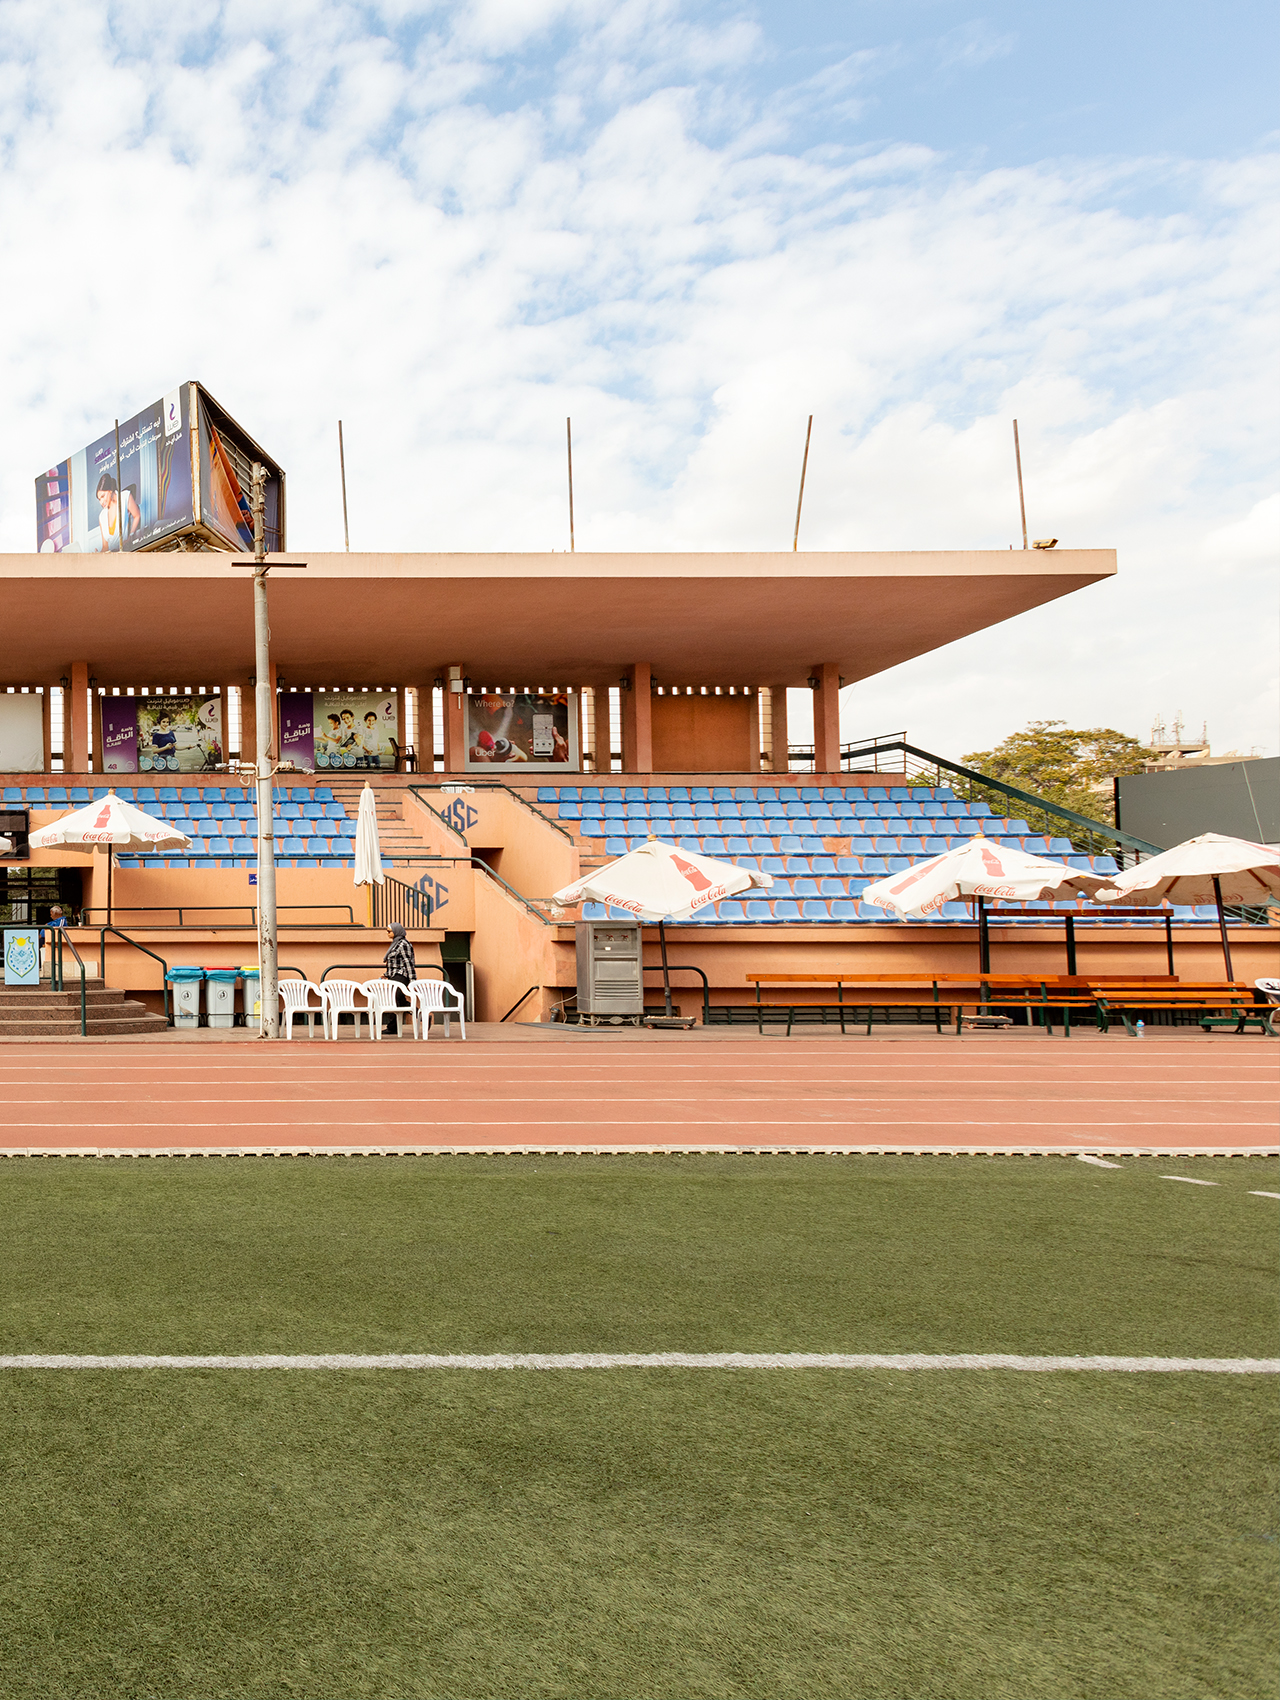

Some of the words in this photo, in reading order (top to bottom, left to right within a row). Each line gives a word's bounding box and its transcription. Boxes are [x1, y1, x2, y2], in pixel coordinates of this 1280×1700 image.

[167, 420, 179, 431] we
[474, 700, 501, 708] Where
[502, 700, 515, 708] to?
[475, 749, 495, 757] Uber
[440, 797, 478, 834] HSC
[406, 873, 449, 917] HSC
